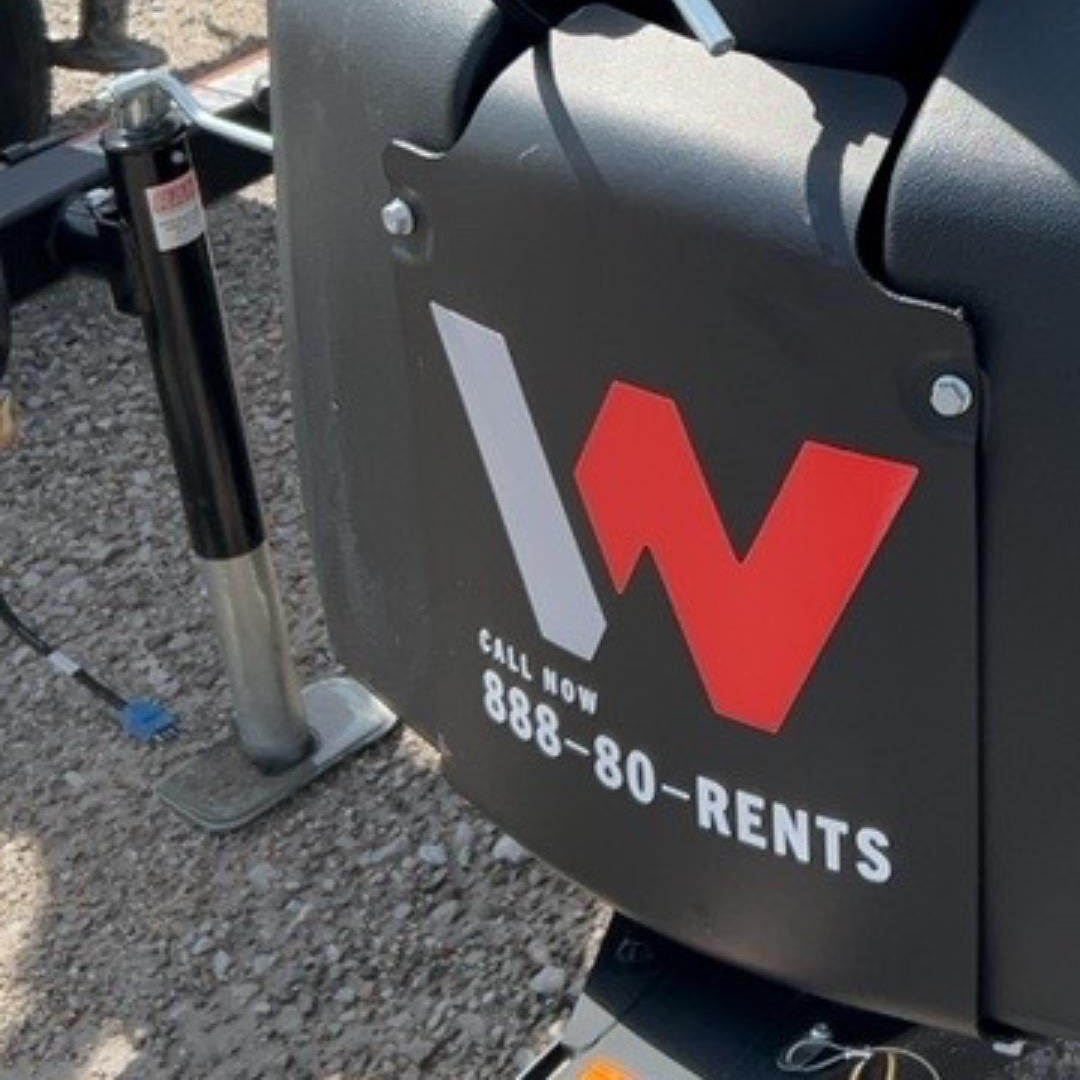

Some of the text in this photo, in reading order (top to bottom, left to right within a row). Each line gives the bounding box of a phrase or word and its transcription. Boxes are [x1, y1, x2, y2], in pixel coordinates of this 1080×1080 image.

[478, 628, 599, 716] CALL NOW
[482, 658, 893, 885] 888-80-RENTS
